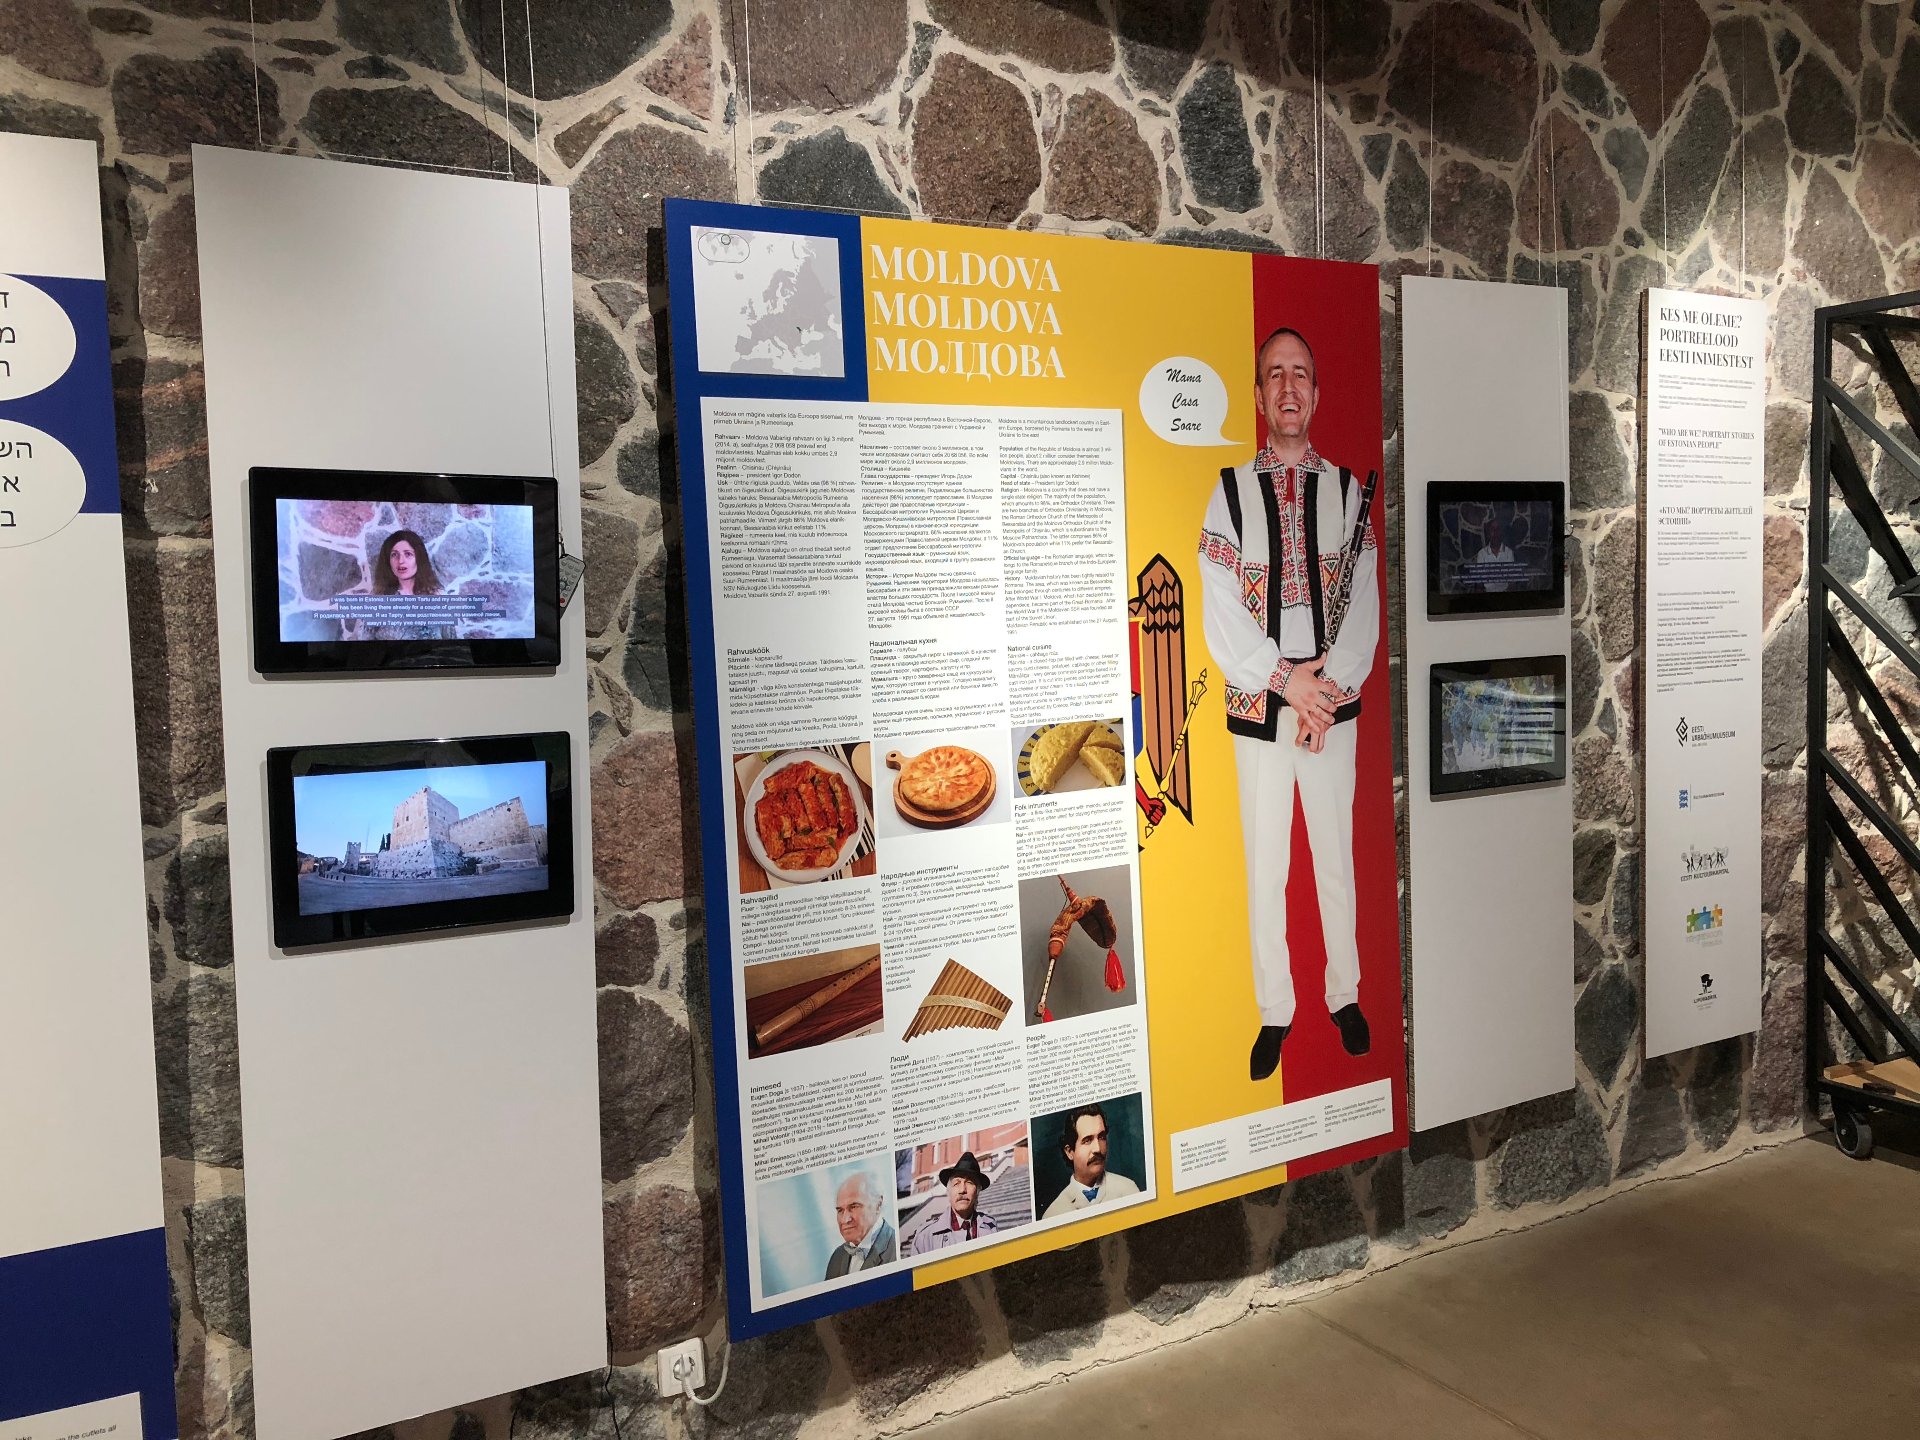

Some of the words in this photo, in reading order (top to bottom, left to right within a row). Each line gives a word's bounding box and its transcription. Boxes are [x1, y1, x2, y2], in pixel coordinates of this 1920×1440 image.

[870, 244, 1062, 292] MOLDOVA
[871, 290, 1064, 336] MOLDOVA
[1660, 308, 1680, 322] KES
[1682, 309, 1699, 324] ME
[1701, 312, 1742, 329] OLEME?
[1659, 328, 1739, 348] PORTREELOOD
[874, 336, 1066, 383] МОЛДОВА
[1659, 348, 1690, 364] EESTI
[1692, 351, 1754, 369] INIMESTEST
[1166, 368, 1202, 383] Mama
[1172, 392, 1200, 410] Casa
[1170, 418, 1202, 432] Soare
[1677, 428, 1688, 437] ARE
[1688, 429, 1702, 437] WE?
[1702, 430, 1730, 439] PORTRAIT
[1731, 431, 1755, 440] STORIES
[1658, 439, 1666, 447] OF
[1667, 439, 1697, 448] ESTONIAN
[1691, 506, 1724, 515] ПОРТРЕТЫ
[1724, 506, 1753, 515] ЖИТЕЛЕЙ
[869, 639, 918, 647] Национальная
[919, 638, 937, 646] кухня
[727, 647, 770, 655] Rahvusköök
[880, 871, 915, 880] Народные
[916, 864, 959, 875] инструменты
[740, 894, 779, 905] Rahvapillid
[1026, 1033, 1046, 1043] People
[890, 1054, 910, 1063] Люди
[750, 1082, 781, 1093] Inimesed
[107, 1424, 117, 1432] all
